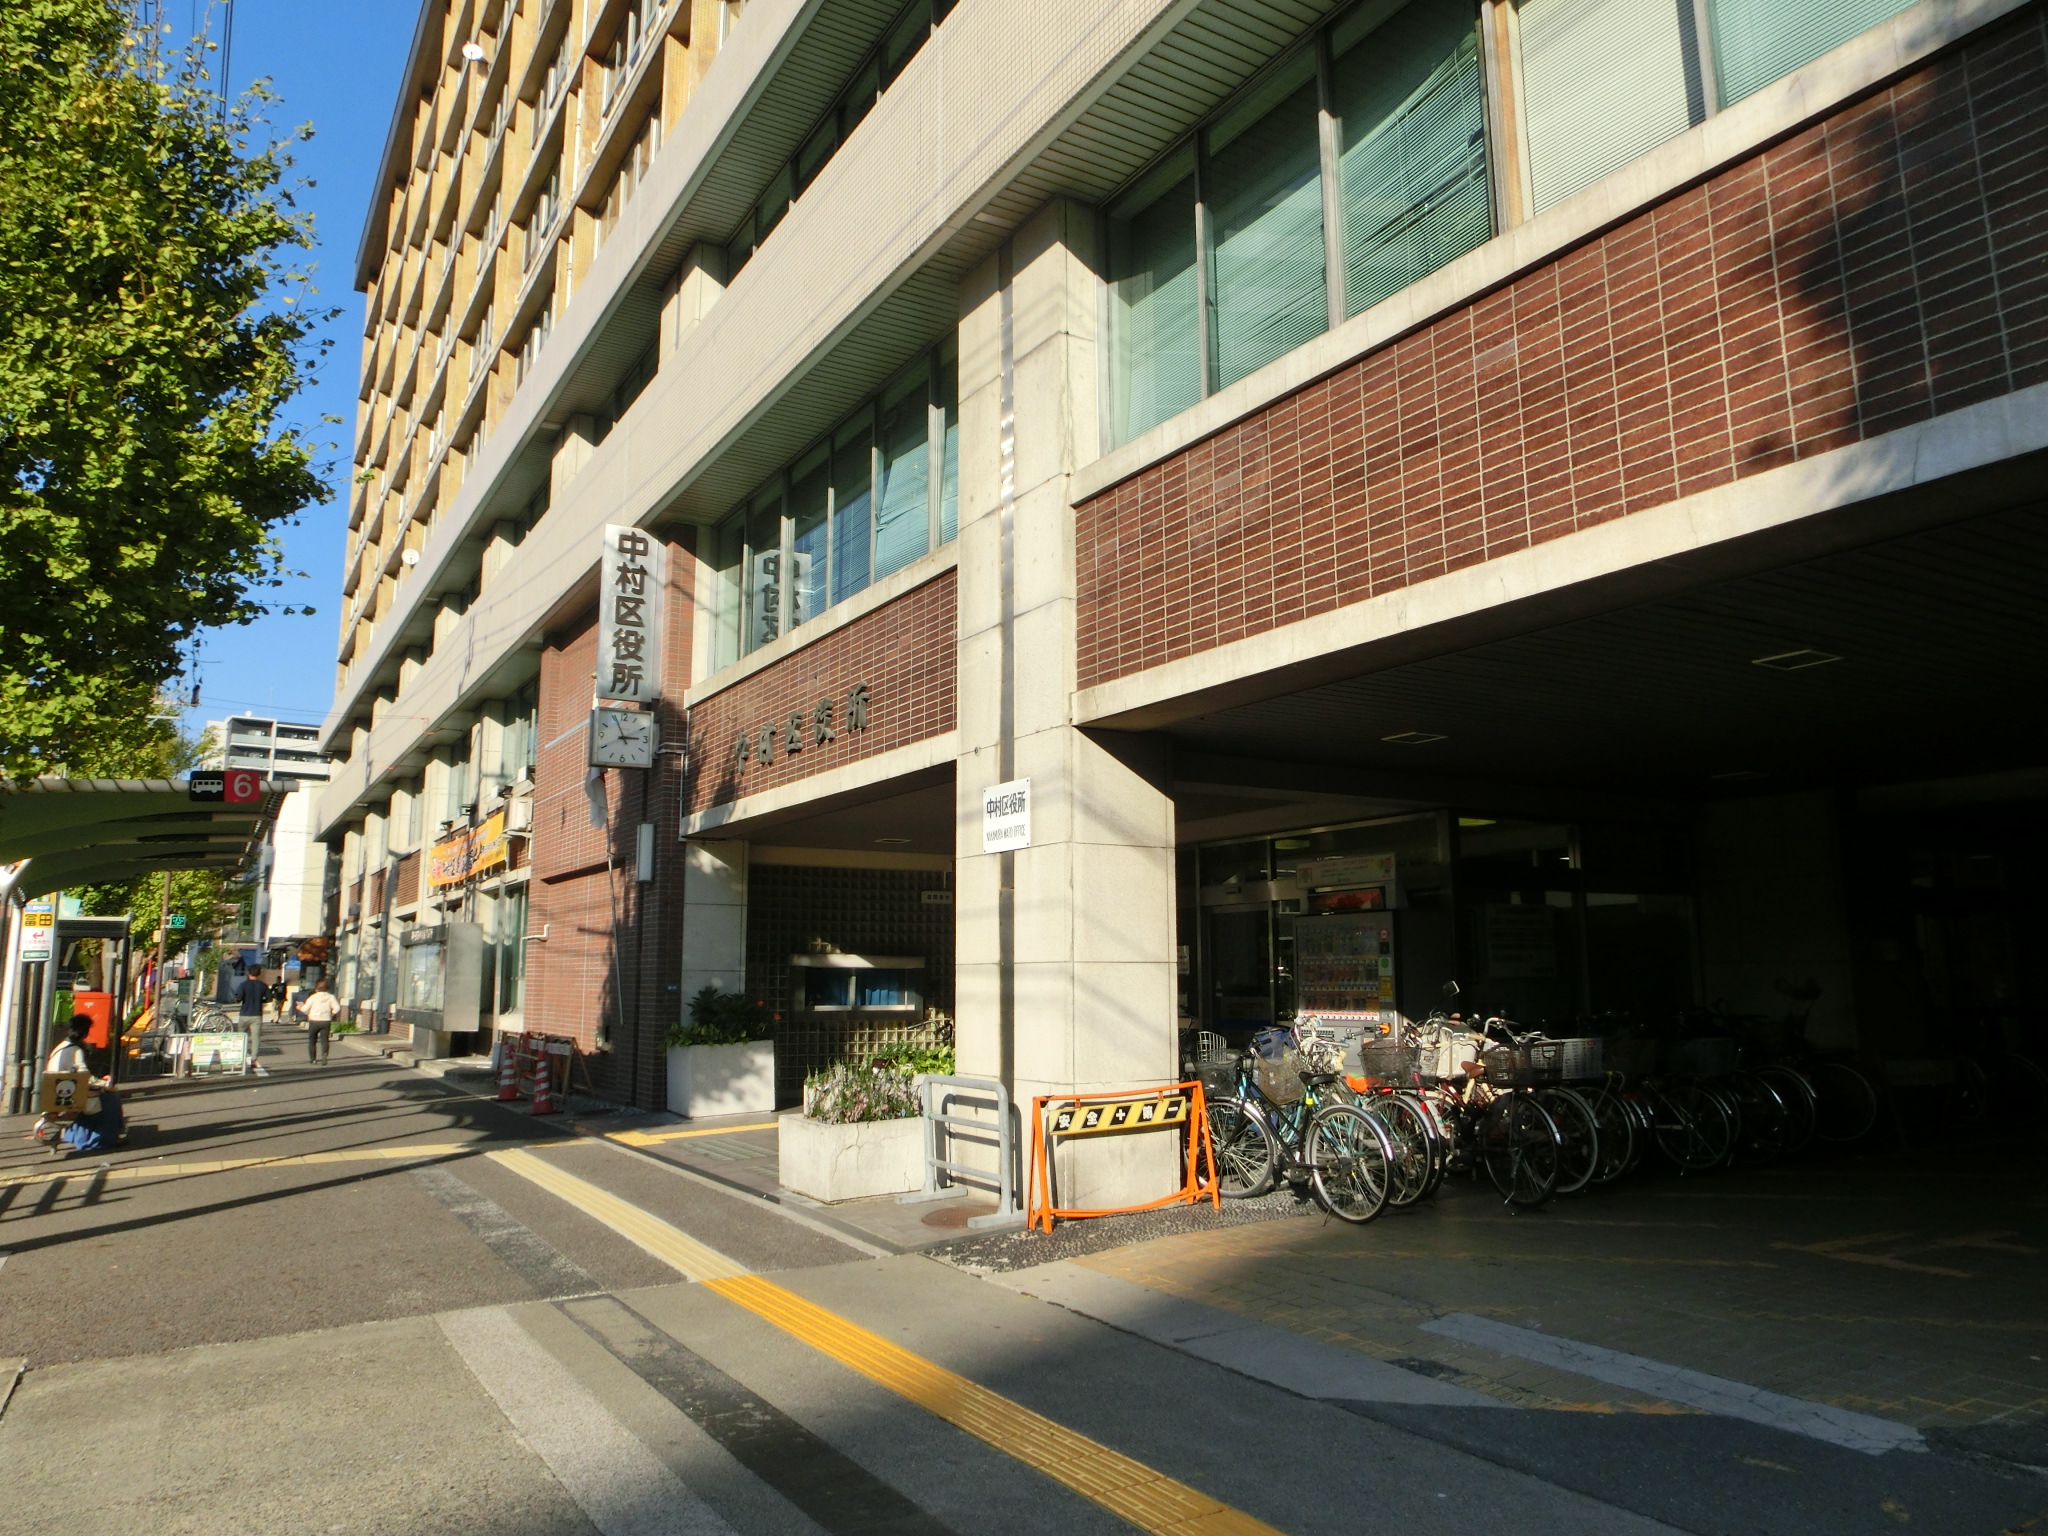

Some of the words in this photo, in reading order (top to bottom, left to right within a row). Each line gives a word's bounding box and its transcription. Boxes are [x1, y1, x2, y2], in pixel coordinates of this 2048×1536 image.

[609, 531, 649, 696] 中村区役所
[620, 713, 628, 722] 12
[599, 731, 605, 740] 9
[643, 735, 649, 744] 3
[619, 754, 626, 763] 6
[234, 774, 253, 798] 6
[986, 791, 1026, 819] 中村区役所
